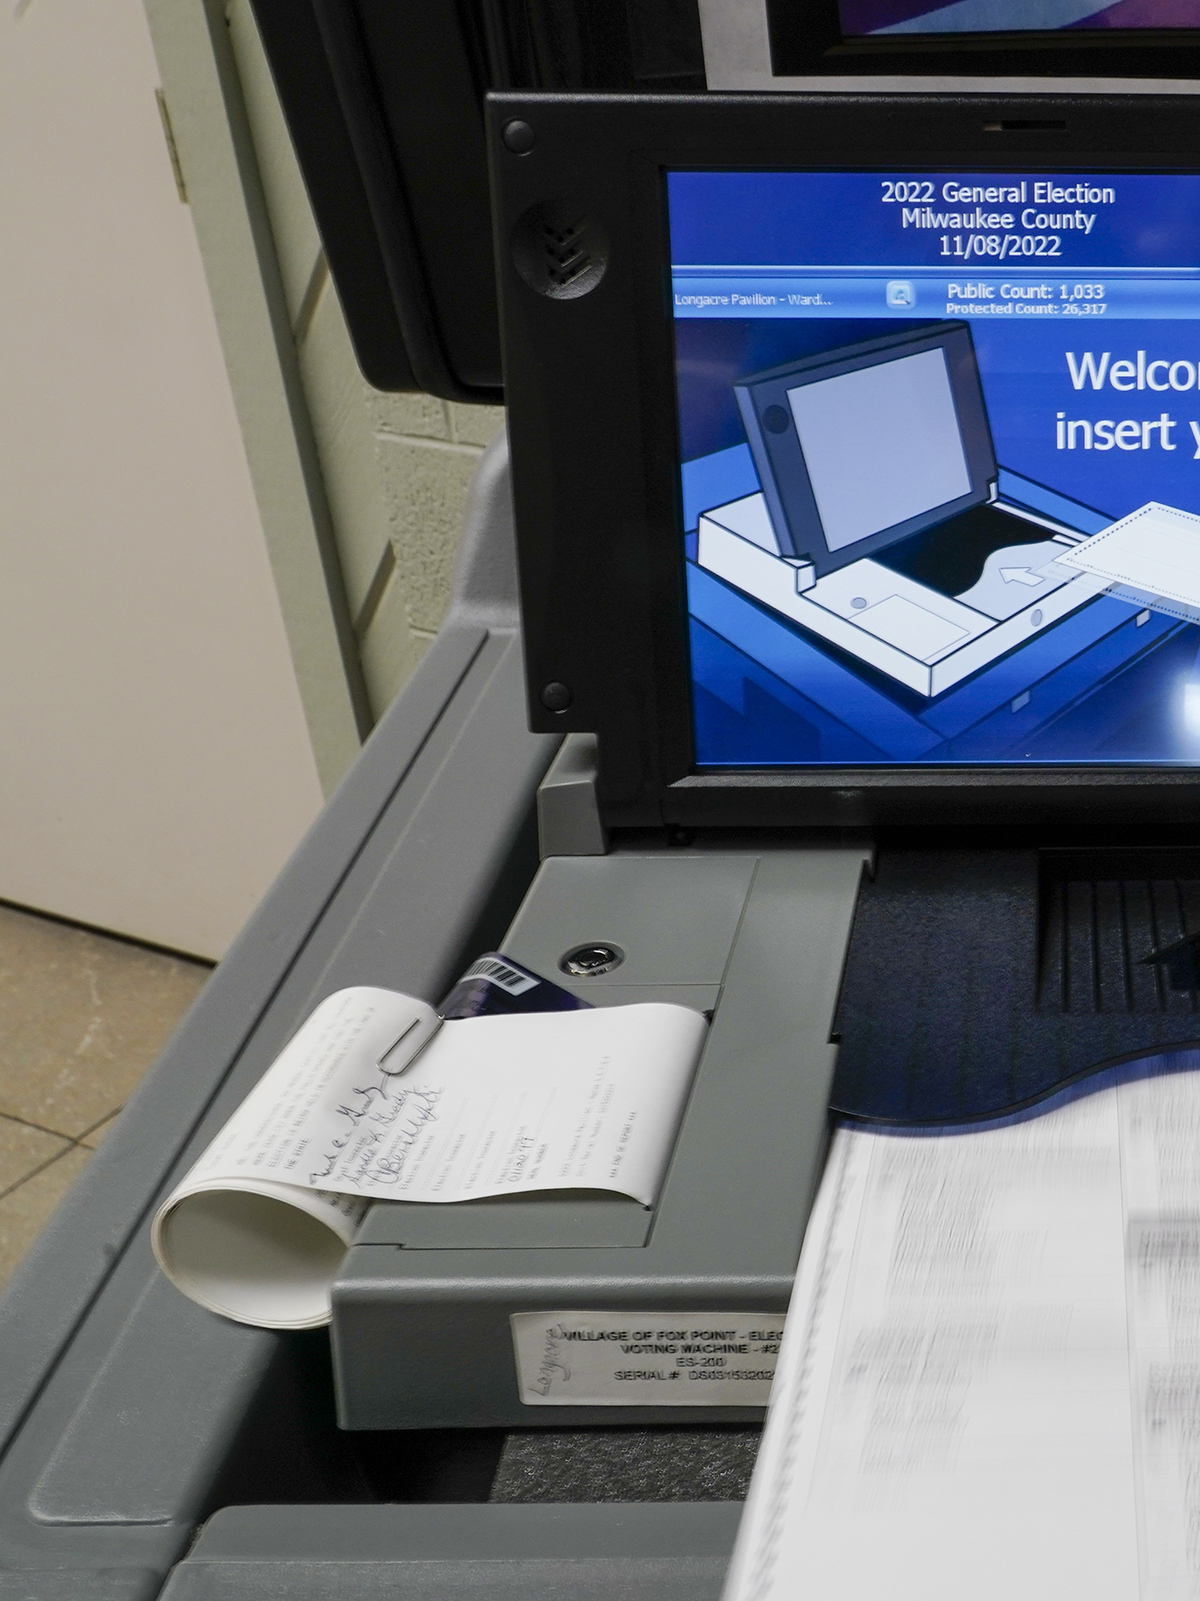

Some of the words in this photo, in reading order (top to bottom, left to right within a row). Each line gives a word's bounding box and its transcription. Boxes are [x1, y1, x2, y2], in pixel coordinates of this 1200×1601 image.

[881, 182, 936, 203] 2022
[942, 182, 1027, 203] General
[1033, 182, 1116, 204] Election
[902, 207, 1015, 229] Milwaukee
[1021, 208, 1097, 234] County
[940, 234, 1063, 260] 11/08/2022
[674, 294, 729, 308] Longacre
[731, 293, 776, 305] Pavilion
[788, 294, 834, 305] Ward...
[948, 283, 996, 299] Public
[1000, 283, 1054, 299] Count:
[1059, 284, 1105, 302] 1,033
[947, 303, 1013, 314] Protected
[1015, 303, 1059, 314] Count:
[1061, 303, 1107, 315] 26,317
[1056, 411, 1178, 451] insert
[563, 1331, 628, 1341] VILLAGE
[632, 1331, 652, 1341] OF
[656, 1331, 688, 1341] FOX
[691, 1331, 737, 1341] POINT
[620, 1344, 676, 1354] VOTING
[680, 1344, 749, 1354] MACHINE
